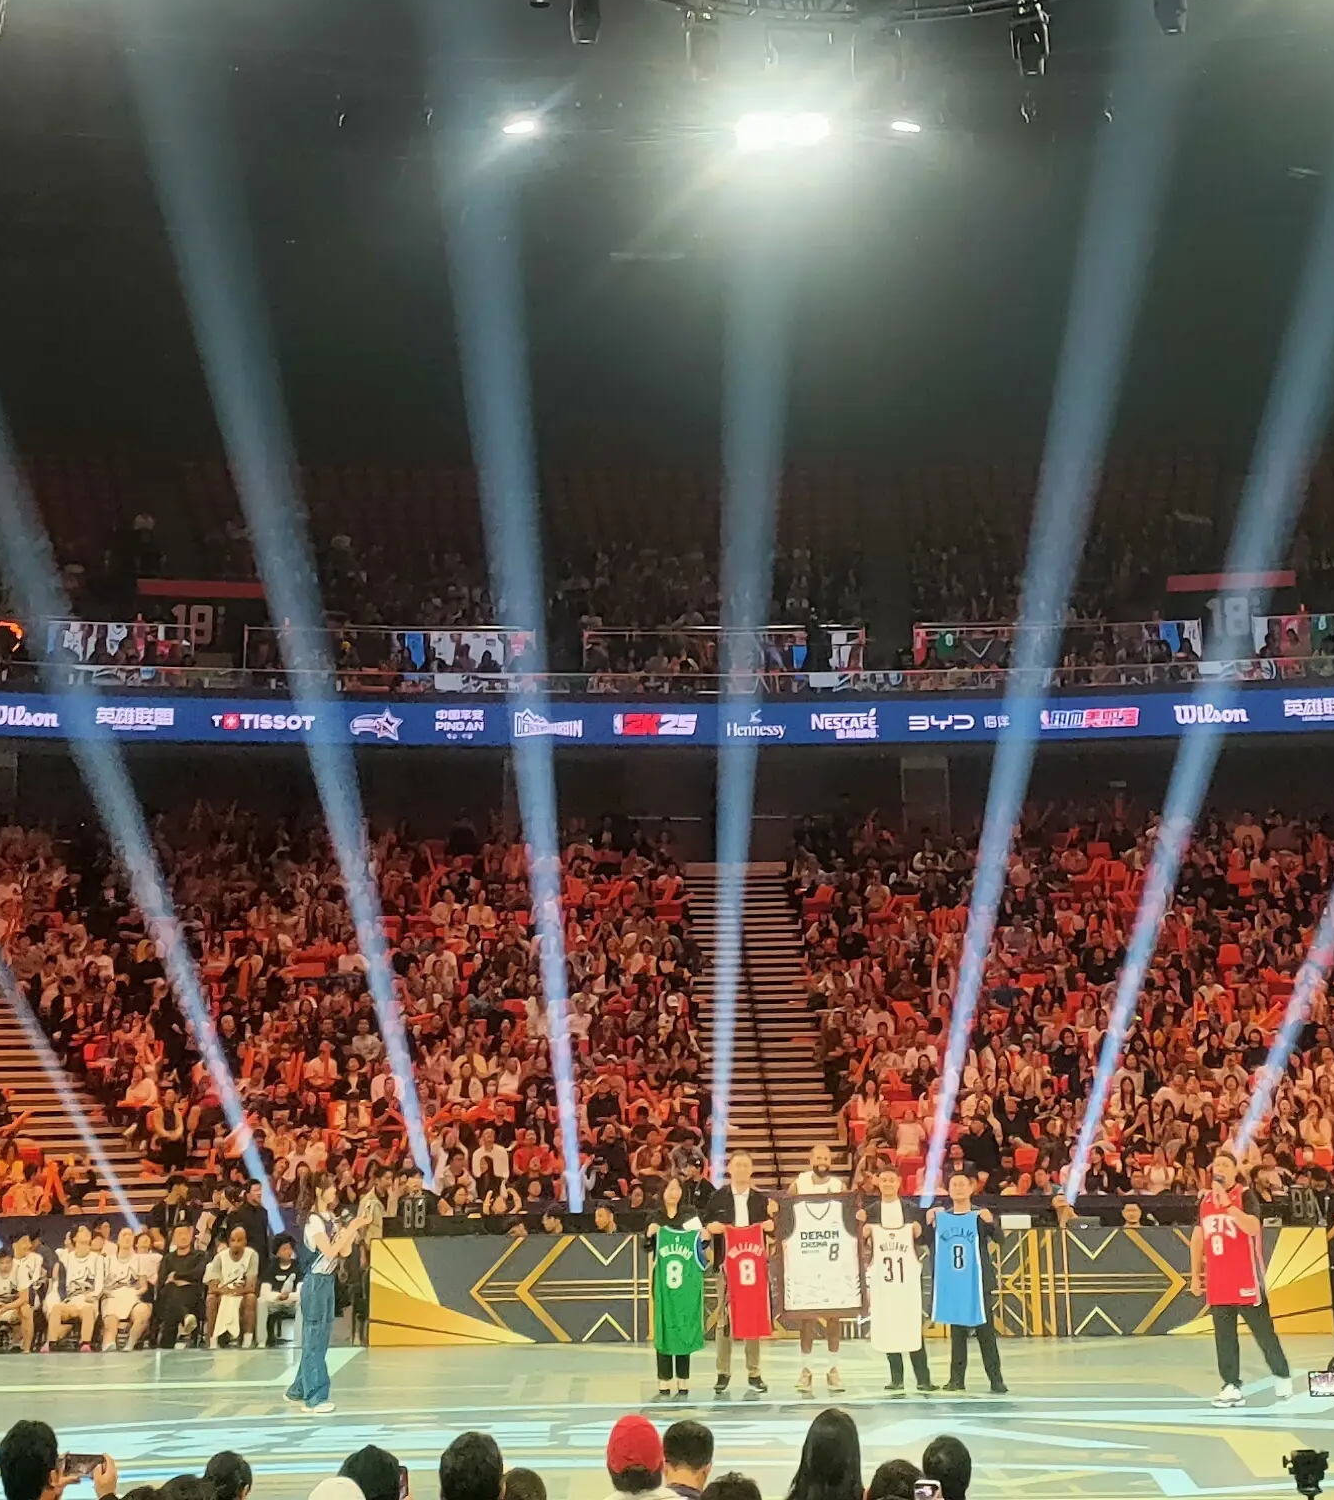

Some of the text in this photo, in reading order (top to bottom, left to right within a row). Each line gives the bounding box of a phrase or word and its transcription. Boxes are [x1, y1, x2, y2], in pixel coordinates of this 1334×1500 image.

[95, 707, 175, 726] 英雄联盟
[239, 713, 316, 730] TISSOT
[811, 707, 877, 730] NESCAFÉ
[908, 714, 976, 731] BYD
[1174, 703, 1250, 725] Wilson
[726, 721, 787, 739] Hennessy
[828, 1243, 840, 1262] 8
[952, 1244, 965, 1271] 8
[666, 1260, 684, 1289] 8
[739, 1259, 756, 1286] 8
[883, 1256, 905, 1283] 31
